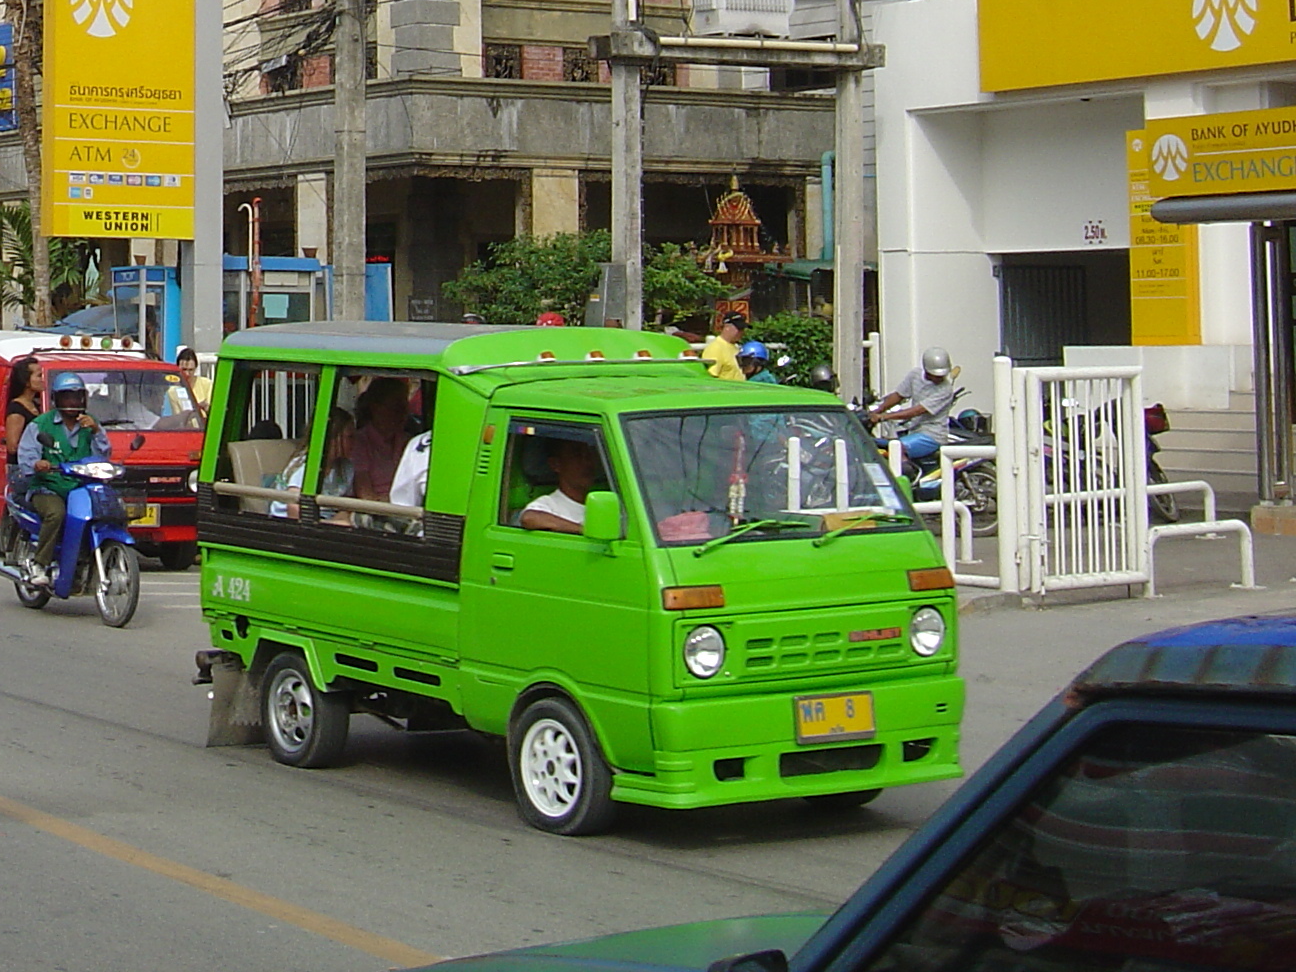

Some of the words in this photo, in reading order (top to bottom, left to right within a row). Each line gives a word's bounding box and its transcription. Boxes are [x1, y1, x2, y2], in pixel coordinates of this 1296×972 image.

[69, 112, 172, 133] EXCHANGE
[1191, 126, 1227, 140] BANK
[1232, 123, 1249, 138] OF
[69, 145, 112, 163] ATM
[83, 210, 150, 222] WESTERN
[104, 221, 150, 232] UNION
[211, 575, 225, 598] A
[228, 577, 251, 602] 424
